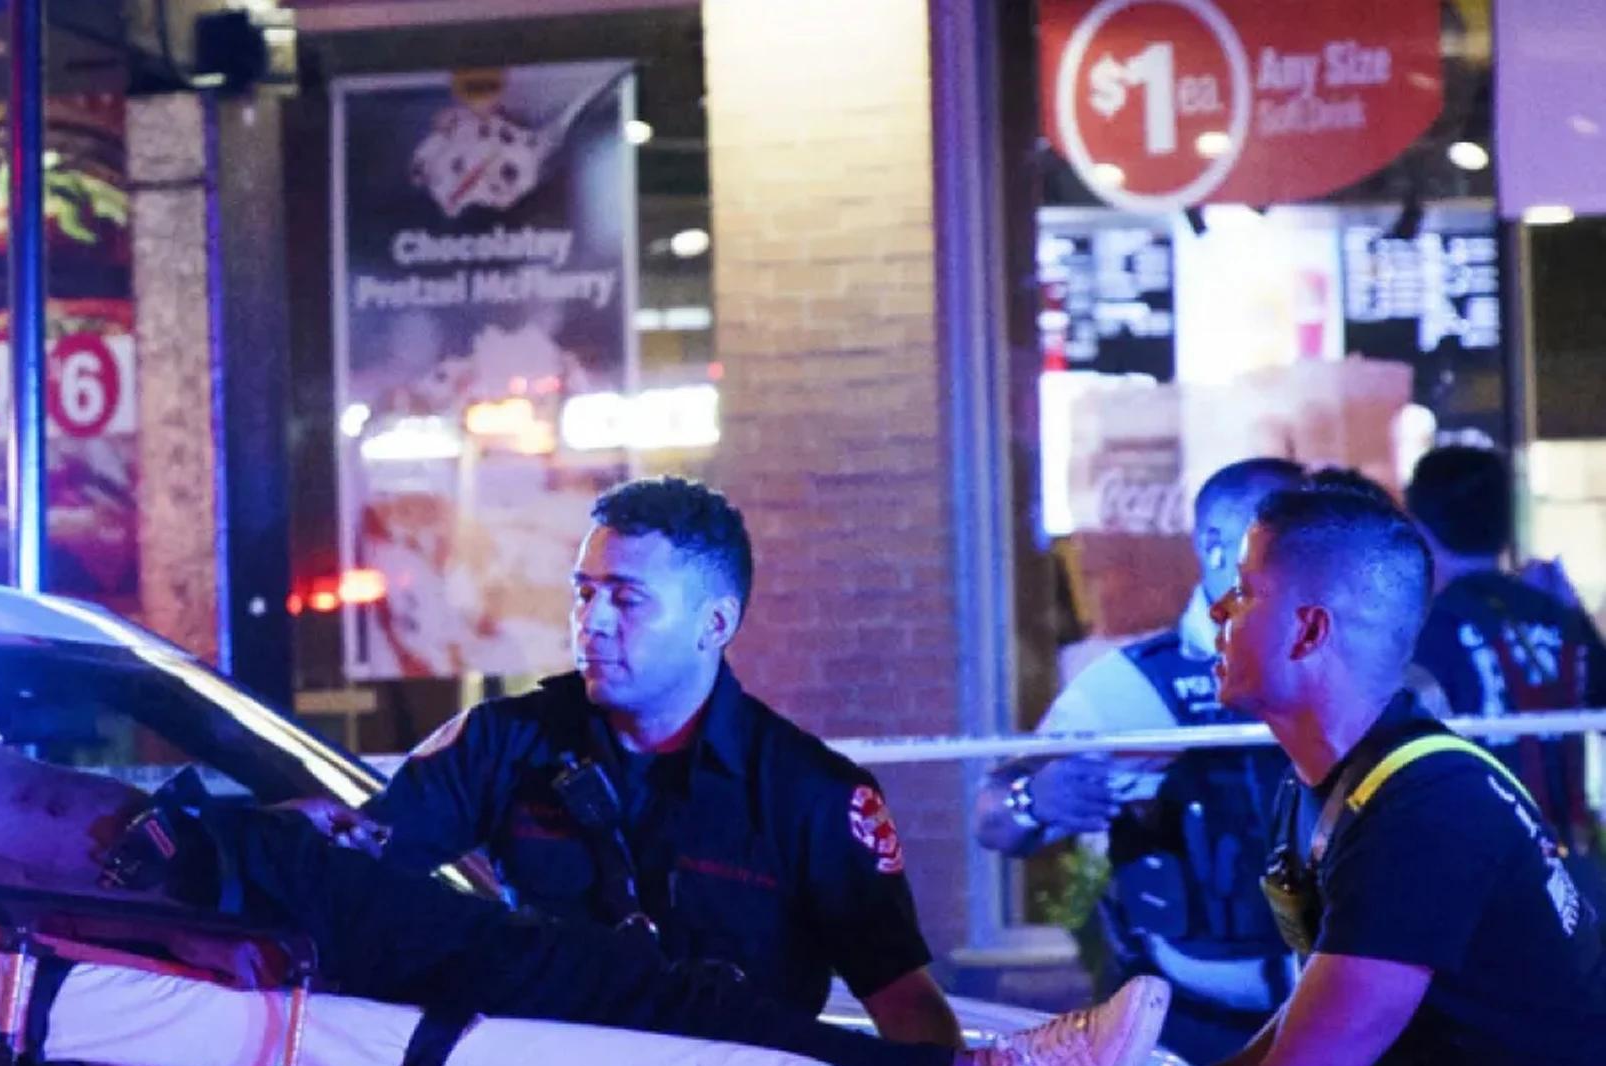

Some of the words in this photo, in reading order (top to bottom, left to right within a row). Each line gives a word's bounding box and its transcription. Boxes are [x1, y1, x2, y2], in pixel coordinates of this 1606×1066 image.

[1088, 40, 1177, 156] $1
[1257, 46, 1320, 98] Any
[1322, 39, 1392, 86] Size
[393, 225, 574, 268] Chocolatey
